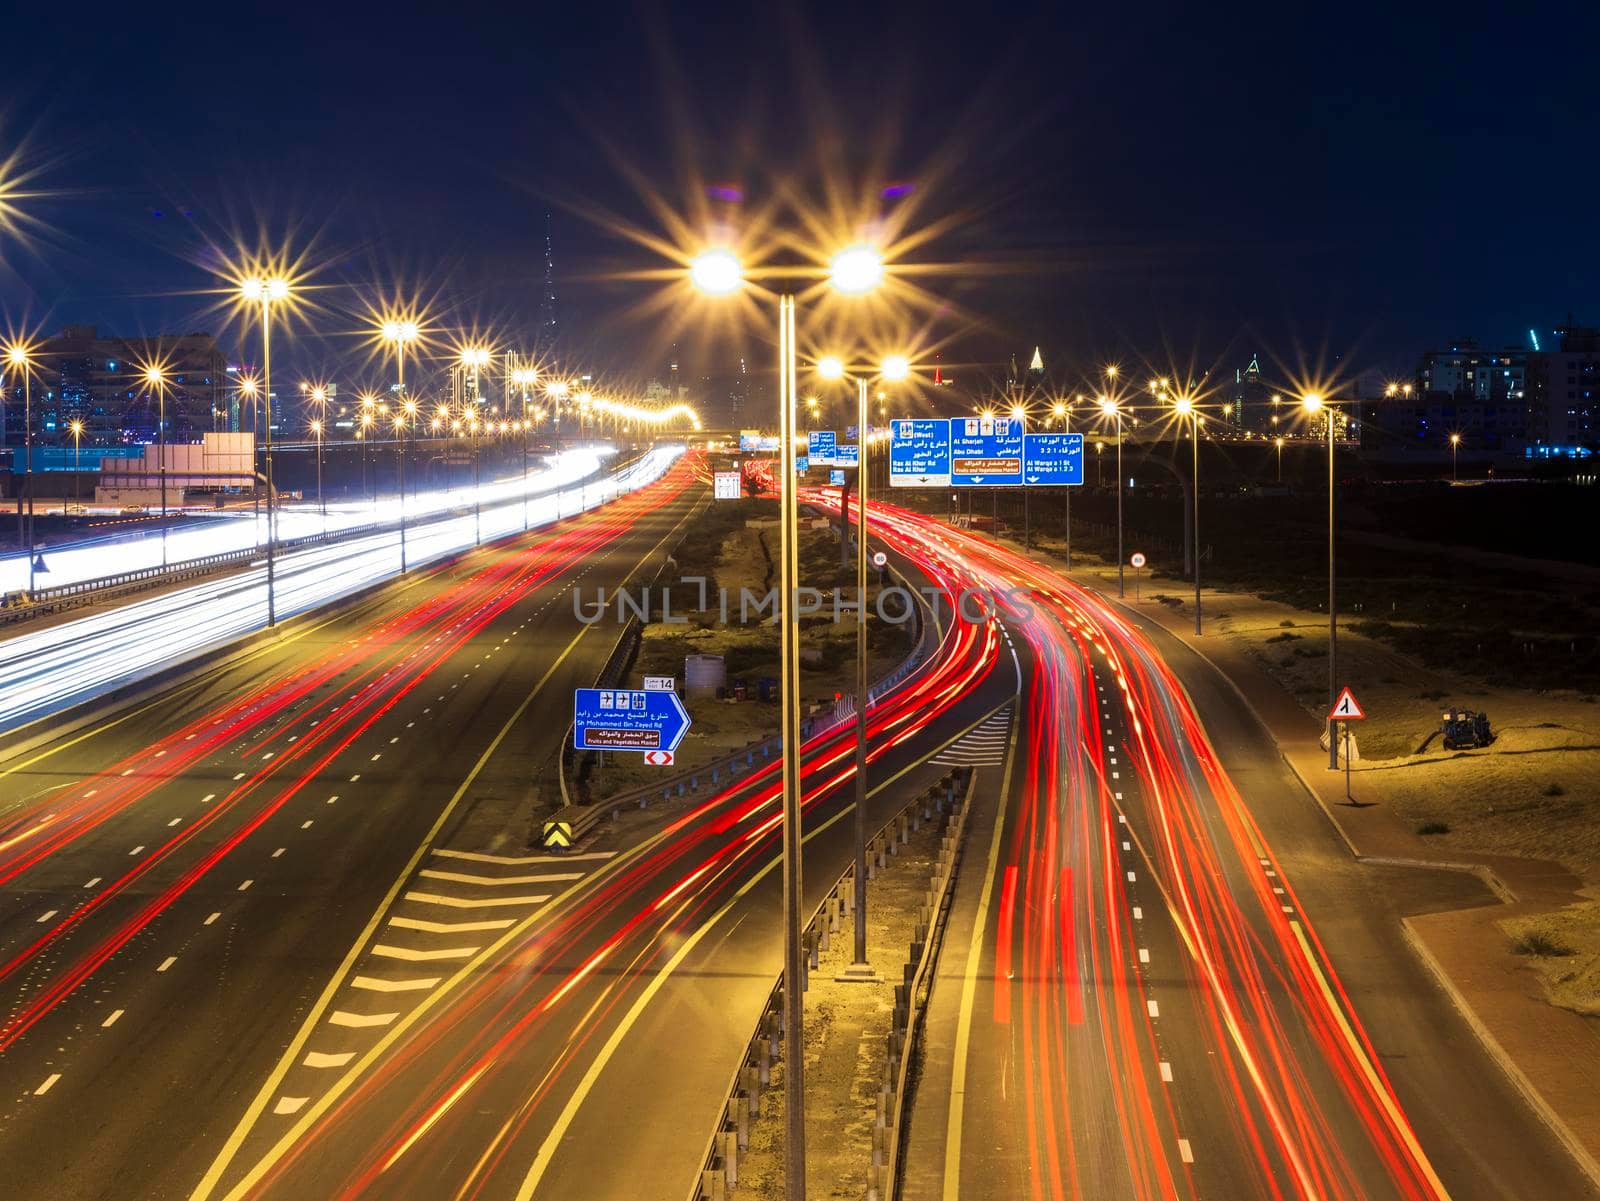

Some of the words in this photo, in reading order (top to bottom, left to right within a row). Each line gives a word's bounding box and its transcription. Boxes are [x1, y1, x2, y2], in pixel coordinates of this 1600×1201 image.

[660, 680, 672, 688] 14
[627, 711, 648, 720] الشيخ
[650, 712, 669, 720] شارع
